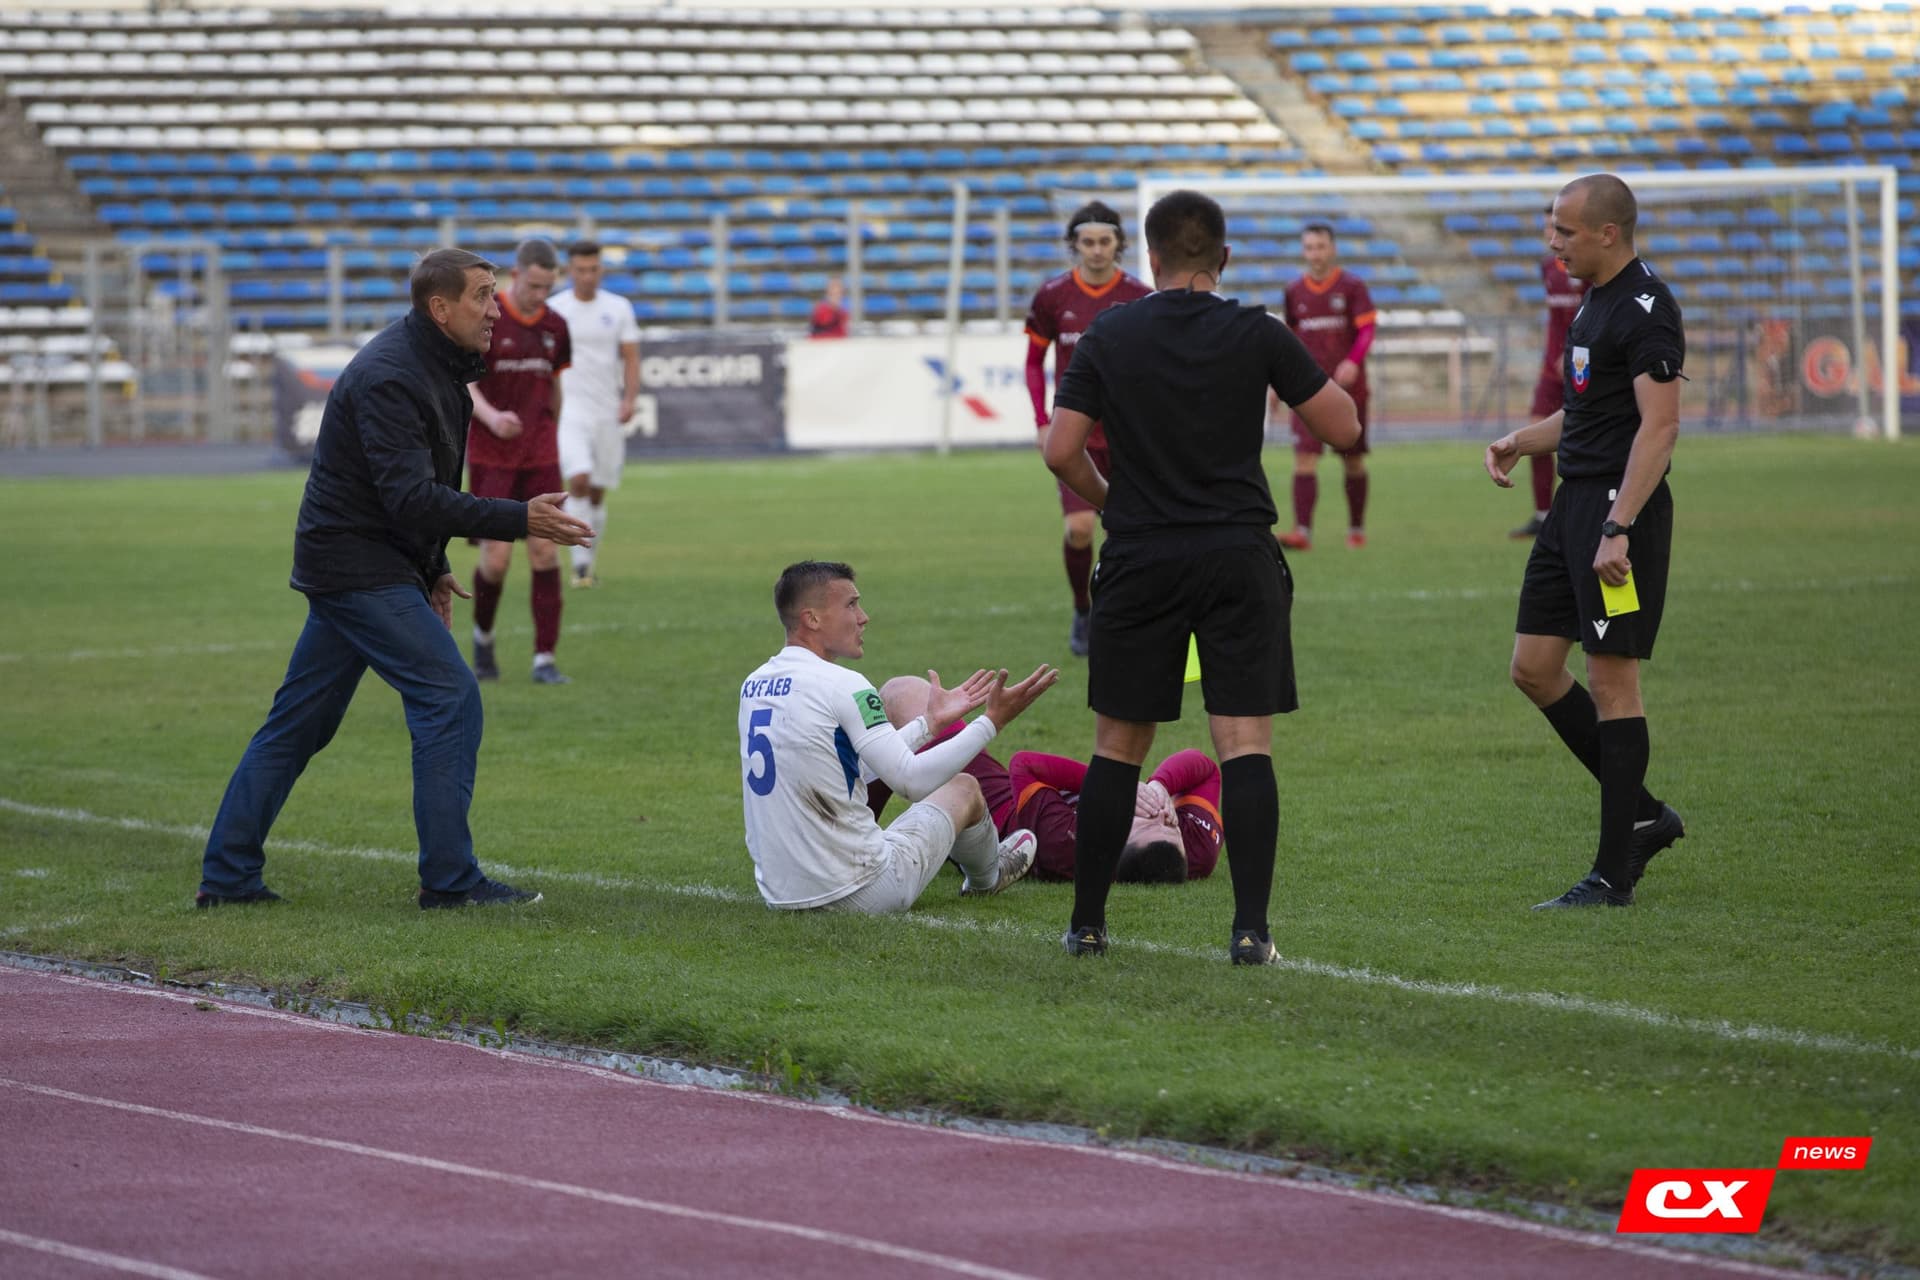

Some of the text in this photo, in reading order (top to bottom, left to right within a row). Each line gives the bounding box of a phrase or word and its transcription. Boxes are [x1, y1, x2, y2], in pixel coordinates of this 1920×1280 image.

[640, 354, 763, 388] ОССИЯ
[741, 677, 792, 699] КУГАЕВ
[746, 708, 777, 796] 5
